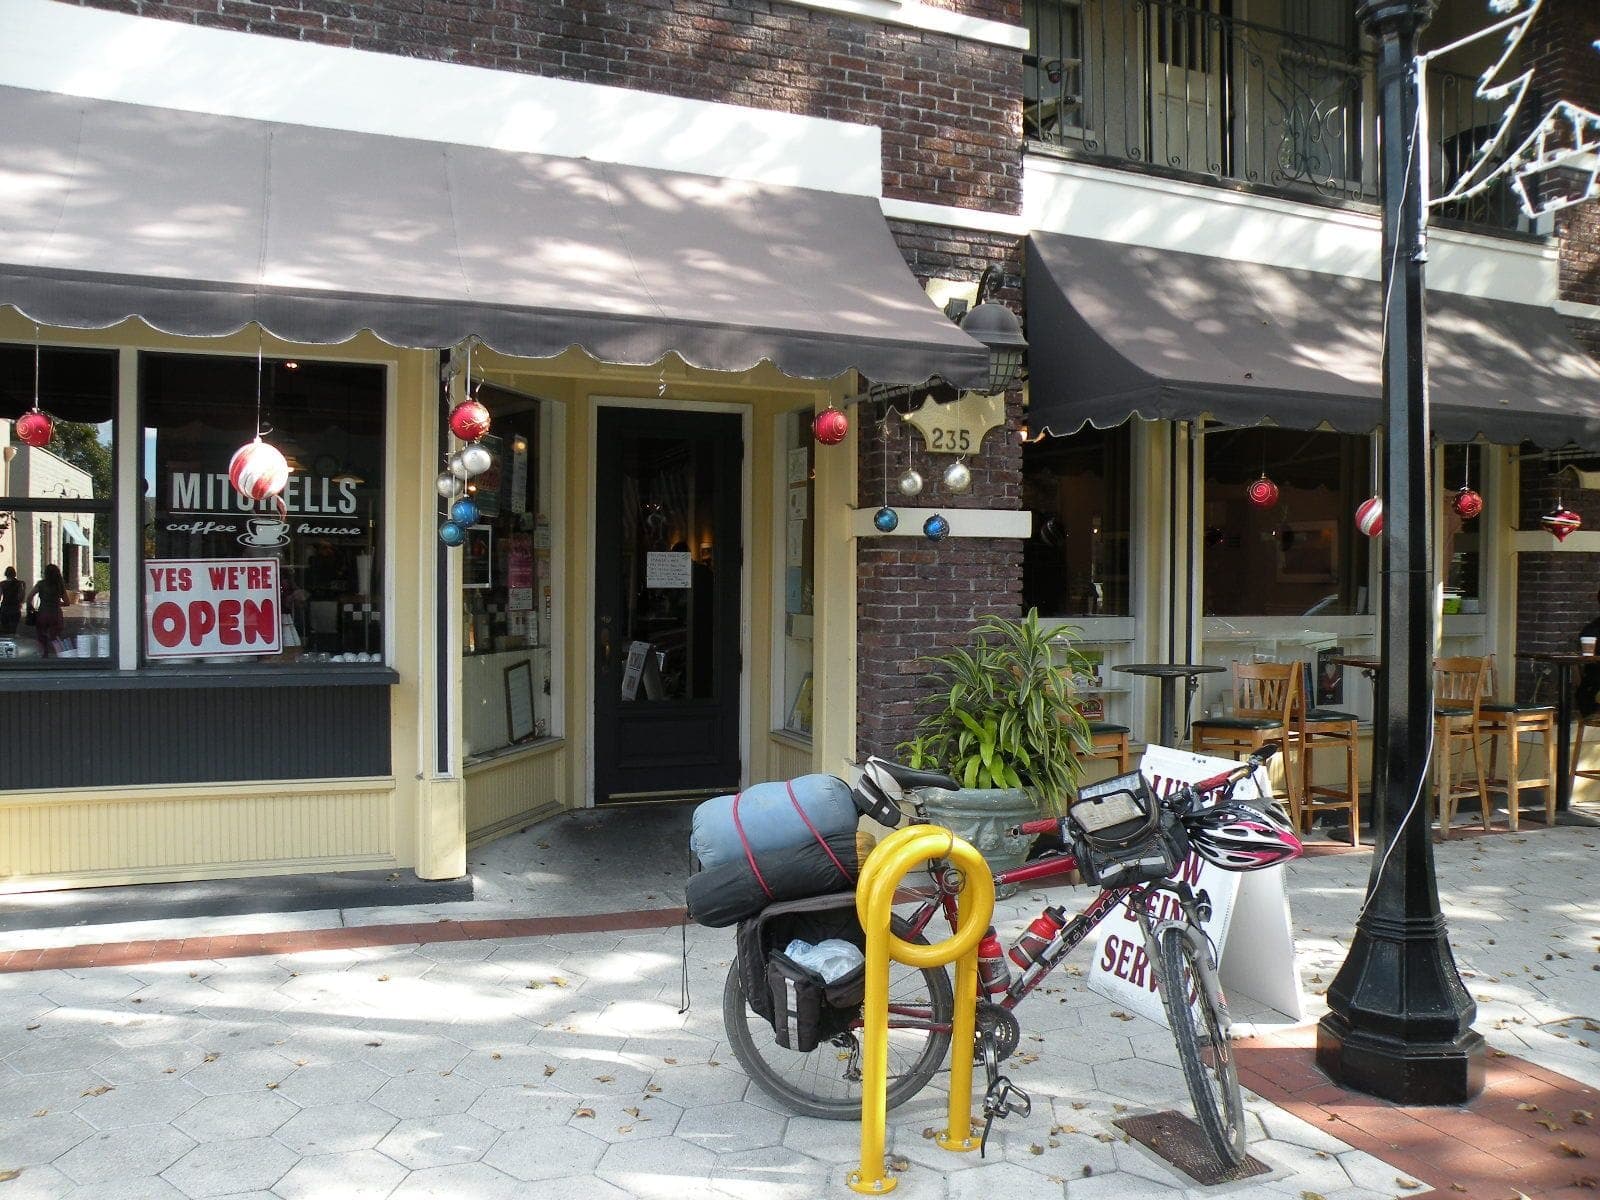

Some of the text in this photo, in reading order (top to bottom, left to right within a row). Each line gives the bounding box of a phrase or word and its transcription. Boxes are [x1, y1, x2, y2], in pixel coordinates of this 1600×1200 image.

[932, 427, 970, 450] 235
[166, 521, 361, 535] coffee house
[150, 566, 272, 592] YES WE'RE
[152, 599, 274, 647] OPEN
